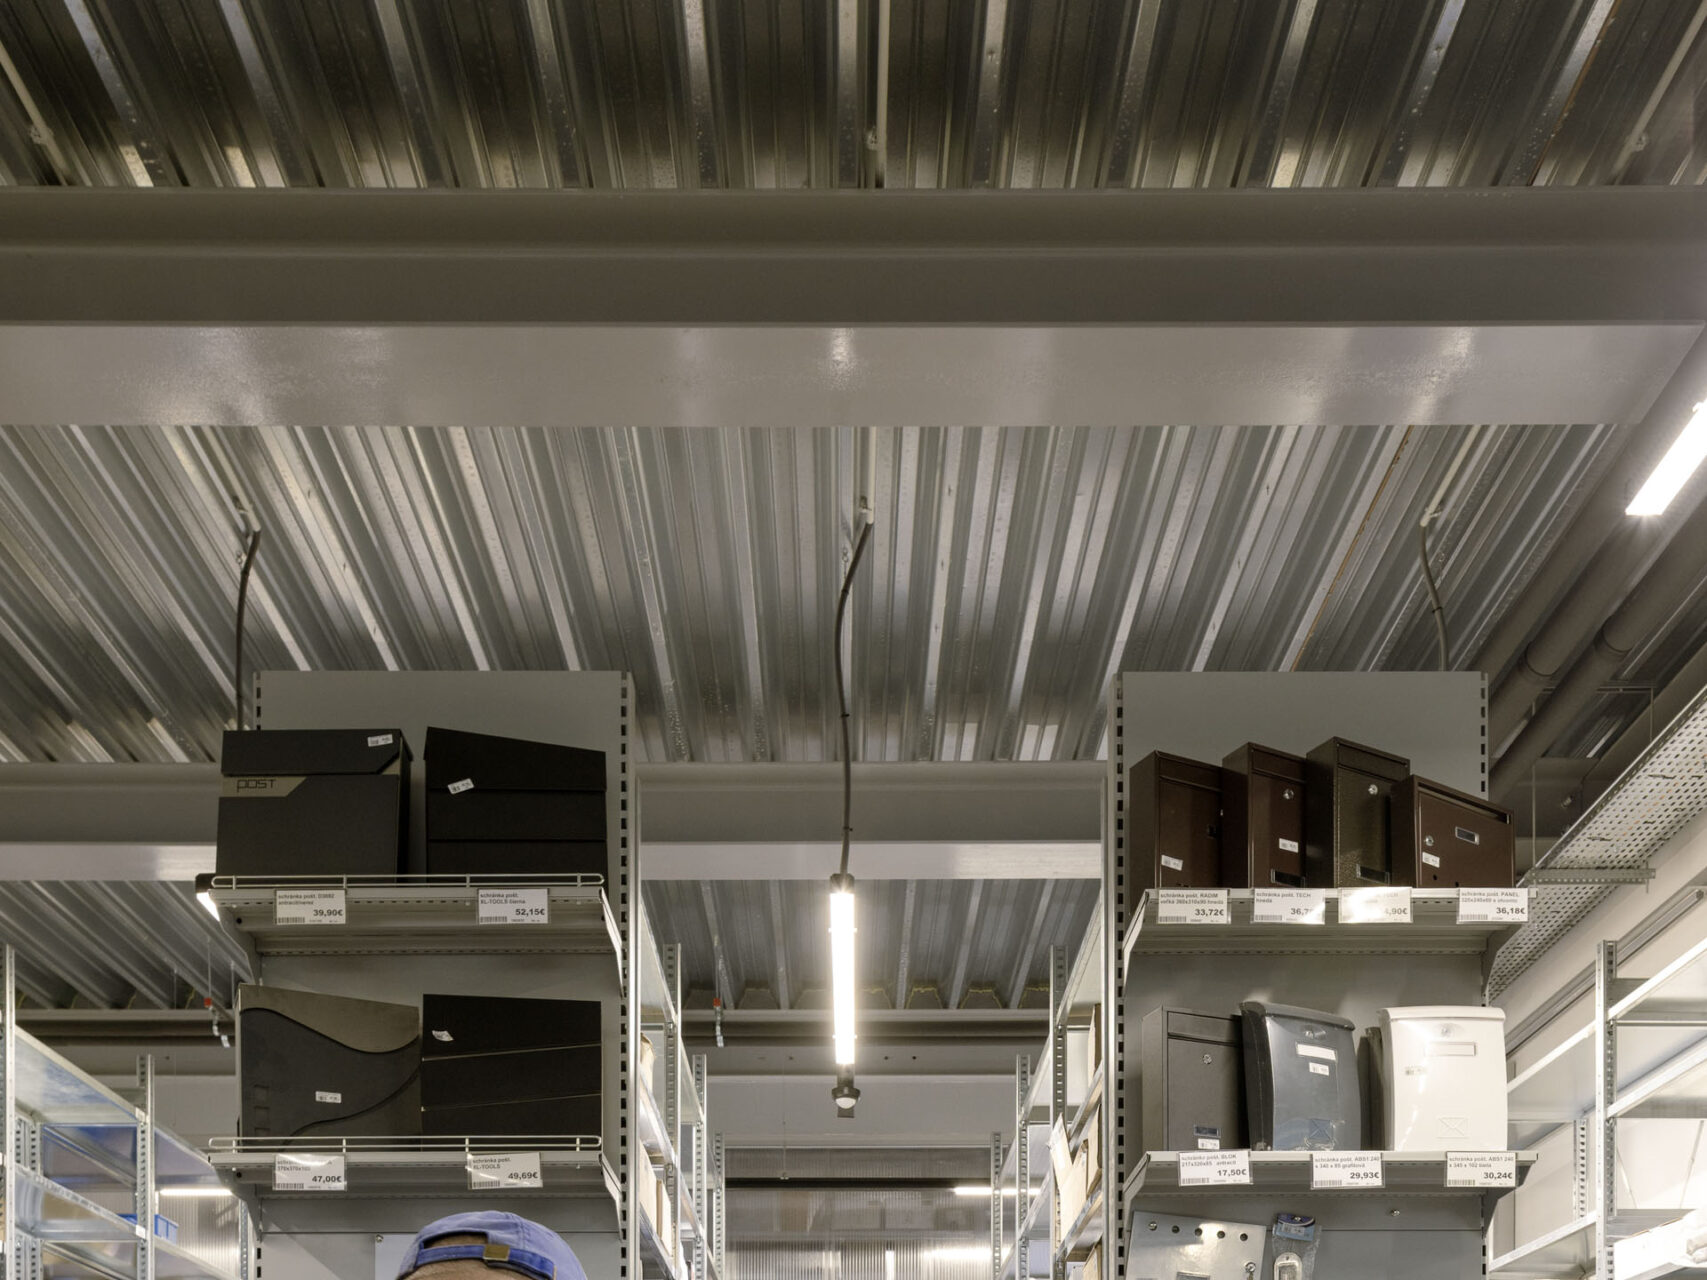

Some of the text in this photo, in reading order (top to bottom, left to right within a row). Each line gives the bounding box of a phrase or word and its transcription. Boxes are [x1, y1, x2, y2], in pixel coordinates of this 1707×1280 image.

[313, 909, 343, 917] 39,90€
[515, 908, 545, 917] 52,15€
[1496, 907, 1525, 915] 36,18€
[508, 1171, 538, 1180] 49,69€
[1217, 1169, 1247, 1177] 17,50€
[1350, 1172, 1380, 1180] 29,93€
[1483, 1172, 1513, 1180] 30,24€
[311, 1175, 342, 1183] 47,00€
